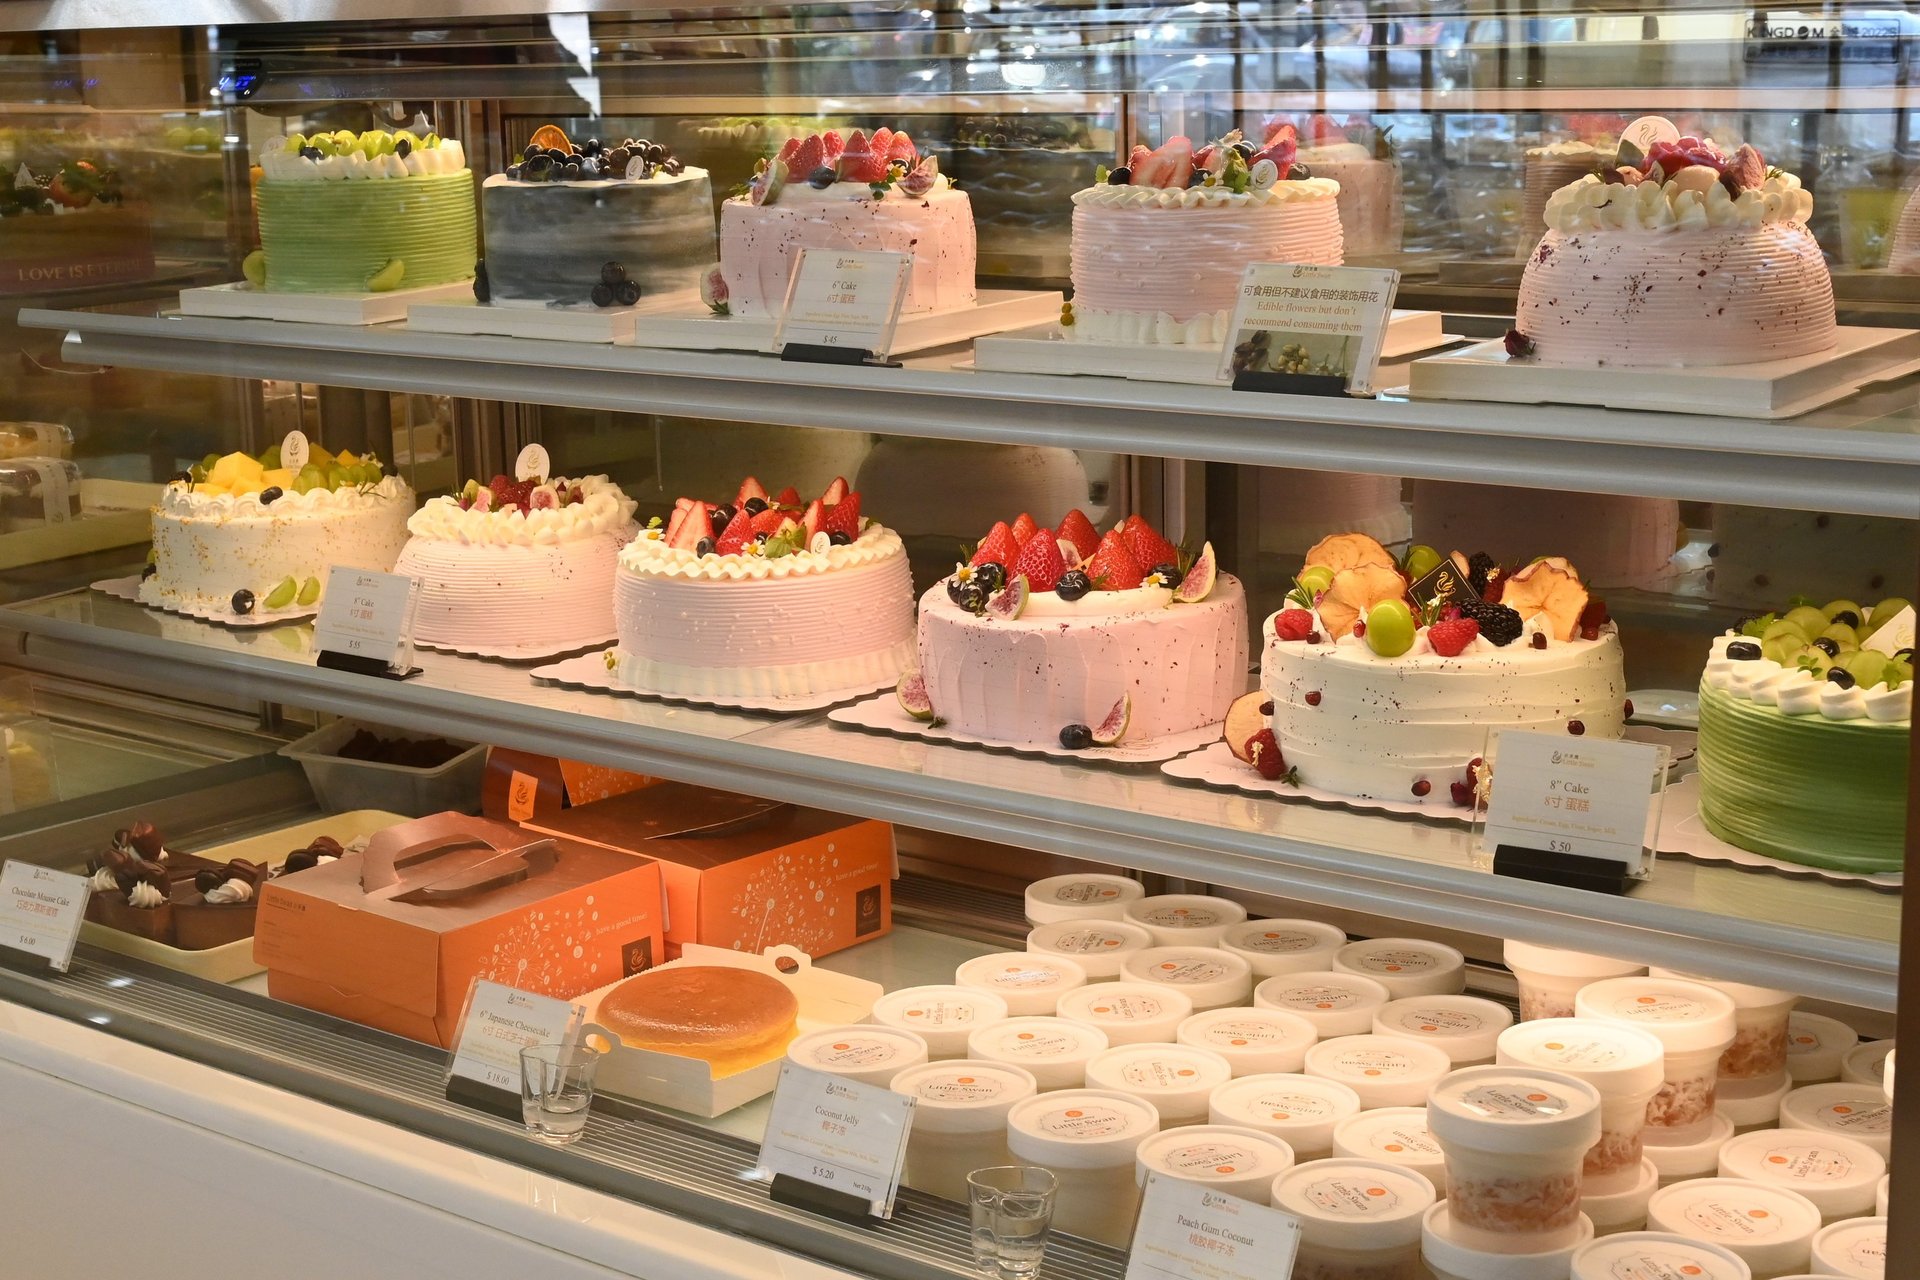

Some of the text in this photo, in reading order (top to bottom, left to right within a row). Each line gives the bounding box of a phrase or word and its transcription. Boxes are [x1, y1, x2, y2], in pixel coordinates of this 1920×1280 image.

[18, 266, 63, 281] LOVE
[69, 264, 84, 278] IS
[841, 281, 857, 290] Cake
[1243, 285, 1380, 303] 可食用但不建议食用的装饰用花
[1257, 301, 1284, 313] Edible
[1285, 303, 1316, 314] flowers
[1318, 304, 1333, 314] but
[1243, 317, 1362, 333] recommend consuming them
[1563, 781, 1589, 794] Cake
[1558, 841, 1571, 852] 50
[488, 1012, 514, 1027] Japanese
[515, 1020, 551, 1038] Cheesecake
[815, 1105, 859, 1127] Coconut Jelly
[818, 1168, 834, 1180] 5.20
[1177, 1214, 1254, 1247] Peach Gum Coconut
